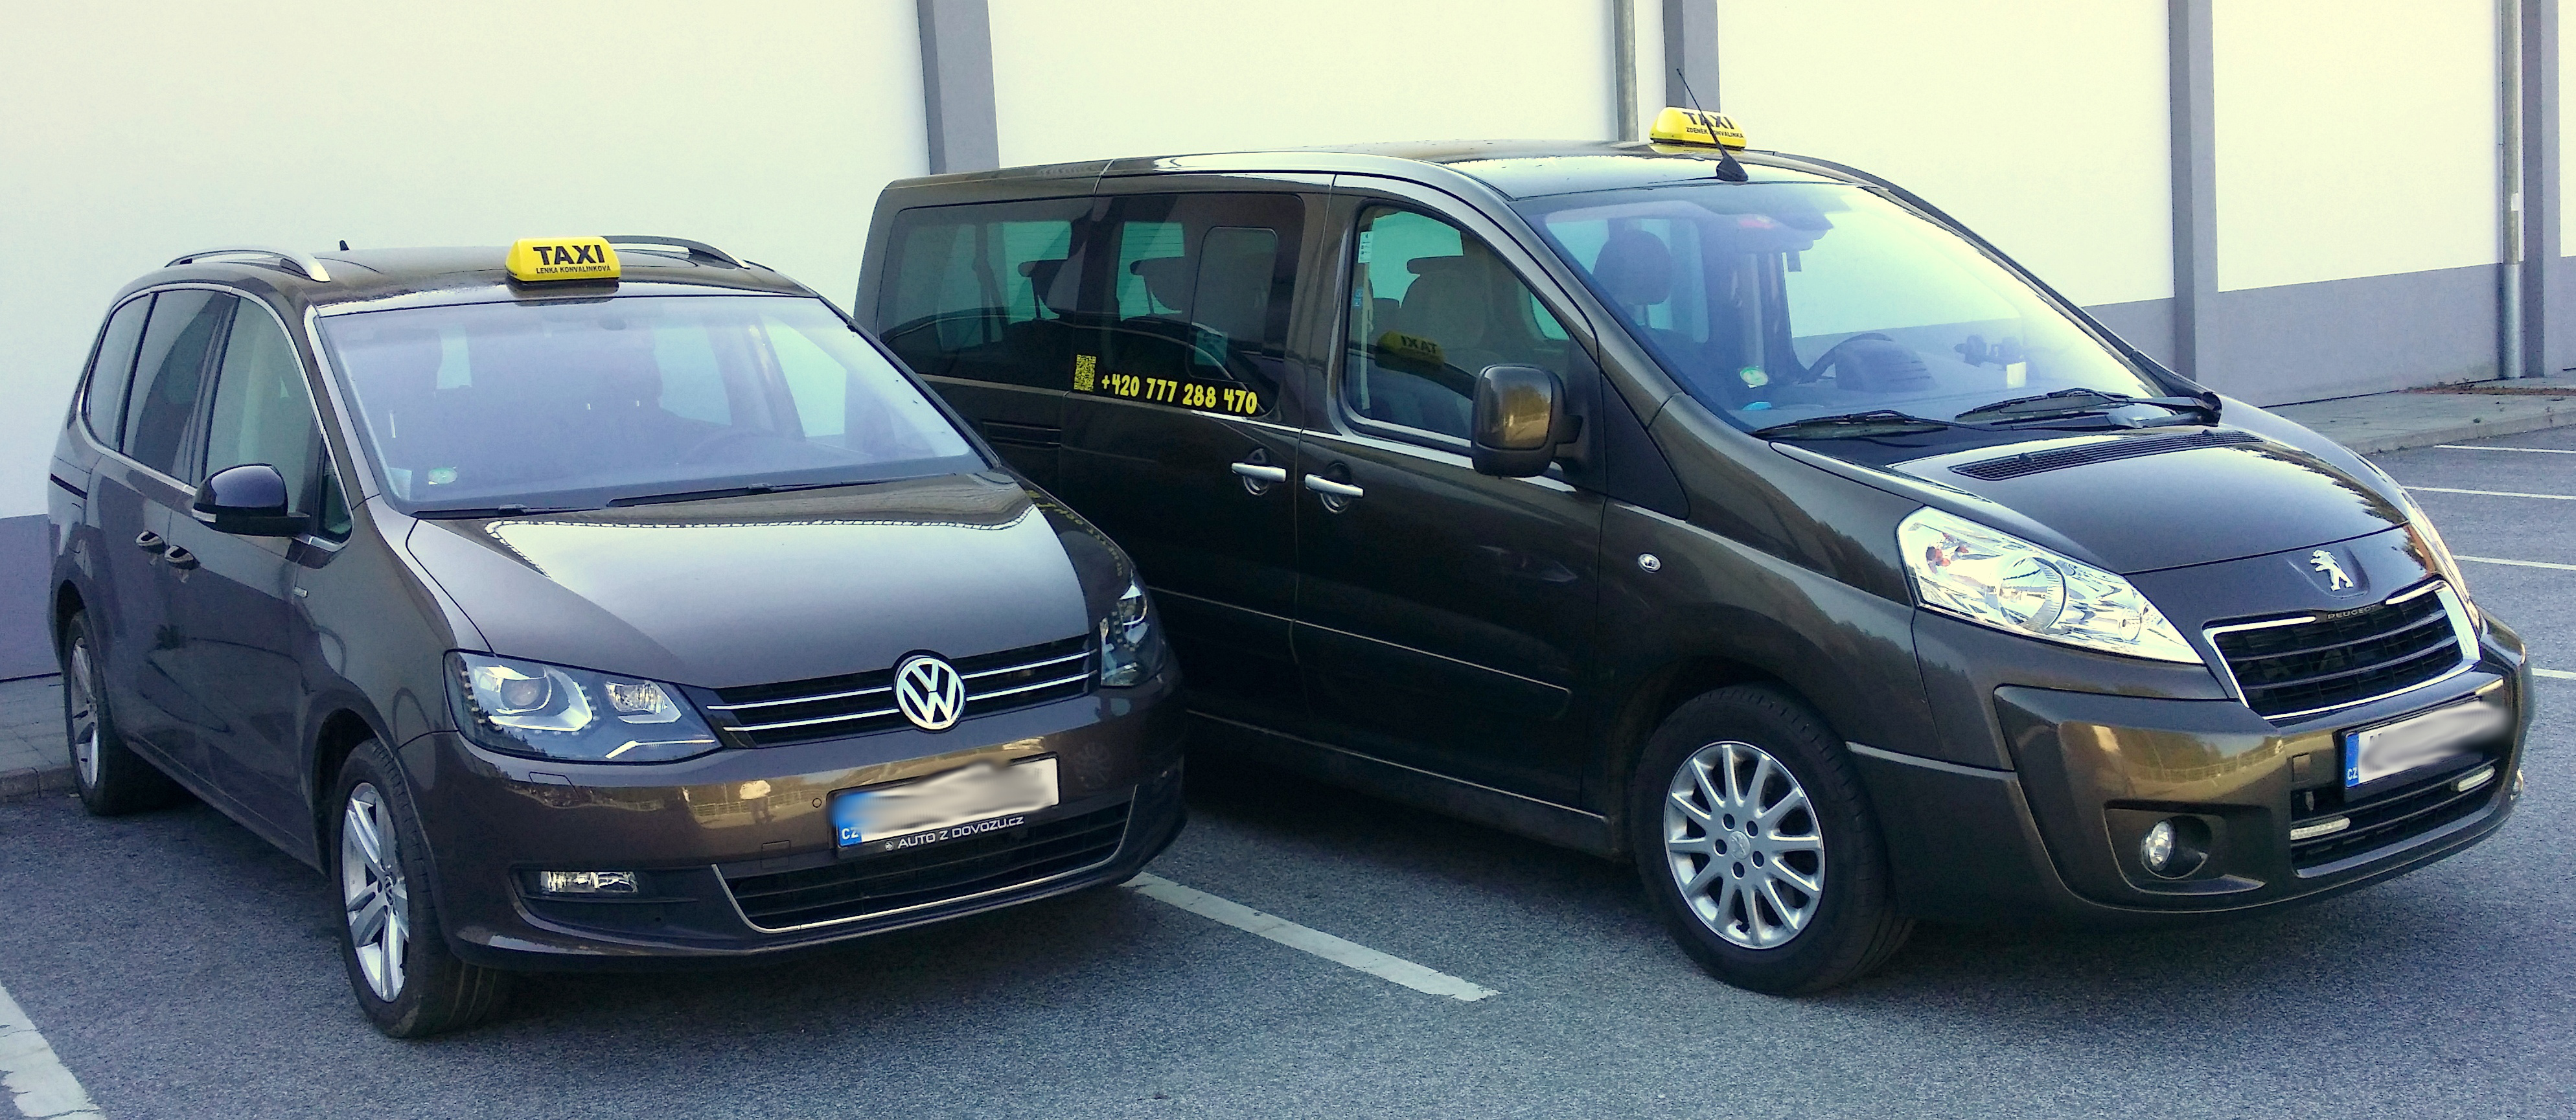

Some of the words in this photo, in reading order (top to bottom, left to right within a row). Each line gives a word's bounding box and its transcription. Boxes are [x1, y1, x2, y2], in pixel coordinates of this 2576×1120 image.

[1683, 111, 1734, 130] TAXI
[533, 245, 606, 266] TAXI
[560, 264, 611, 273] KONVALINKOVÁ
[1101, 374, 1140, 397] +420
[1146, 378, 1178, 402] 777
[1182, 383, 1216, 408] 288
[1224, 388, 1258, 415] 470
[2327, 605, 2376, 619] PEUGEOT
[898, 659, 963, 729] VW
[2347, 767, 2358, 780] CZ
[842, 827, 859, 840] CZ
[897, 832, 936, 849] AUTO
[939, 830, 949, 841] Z
